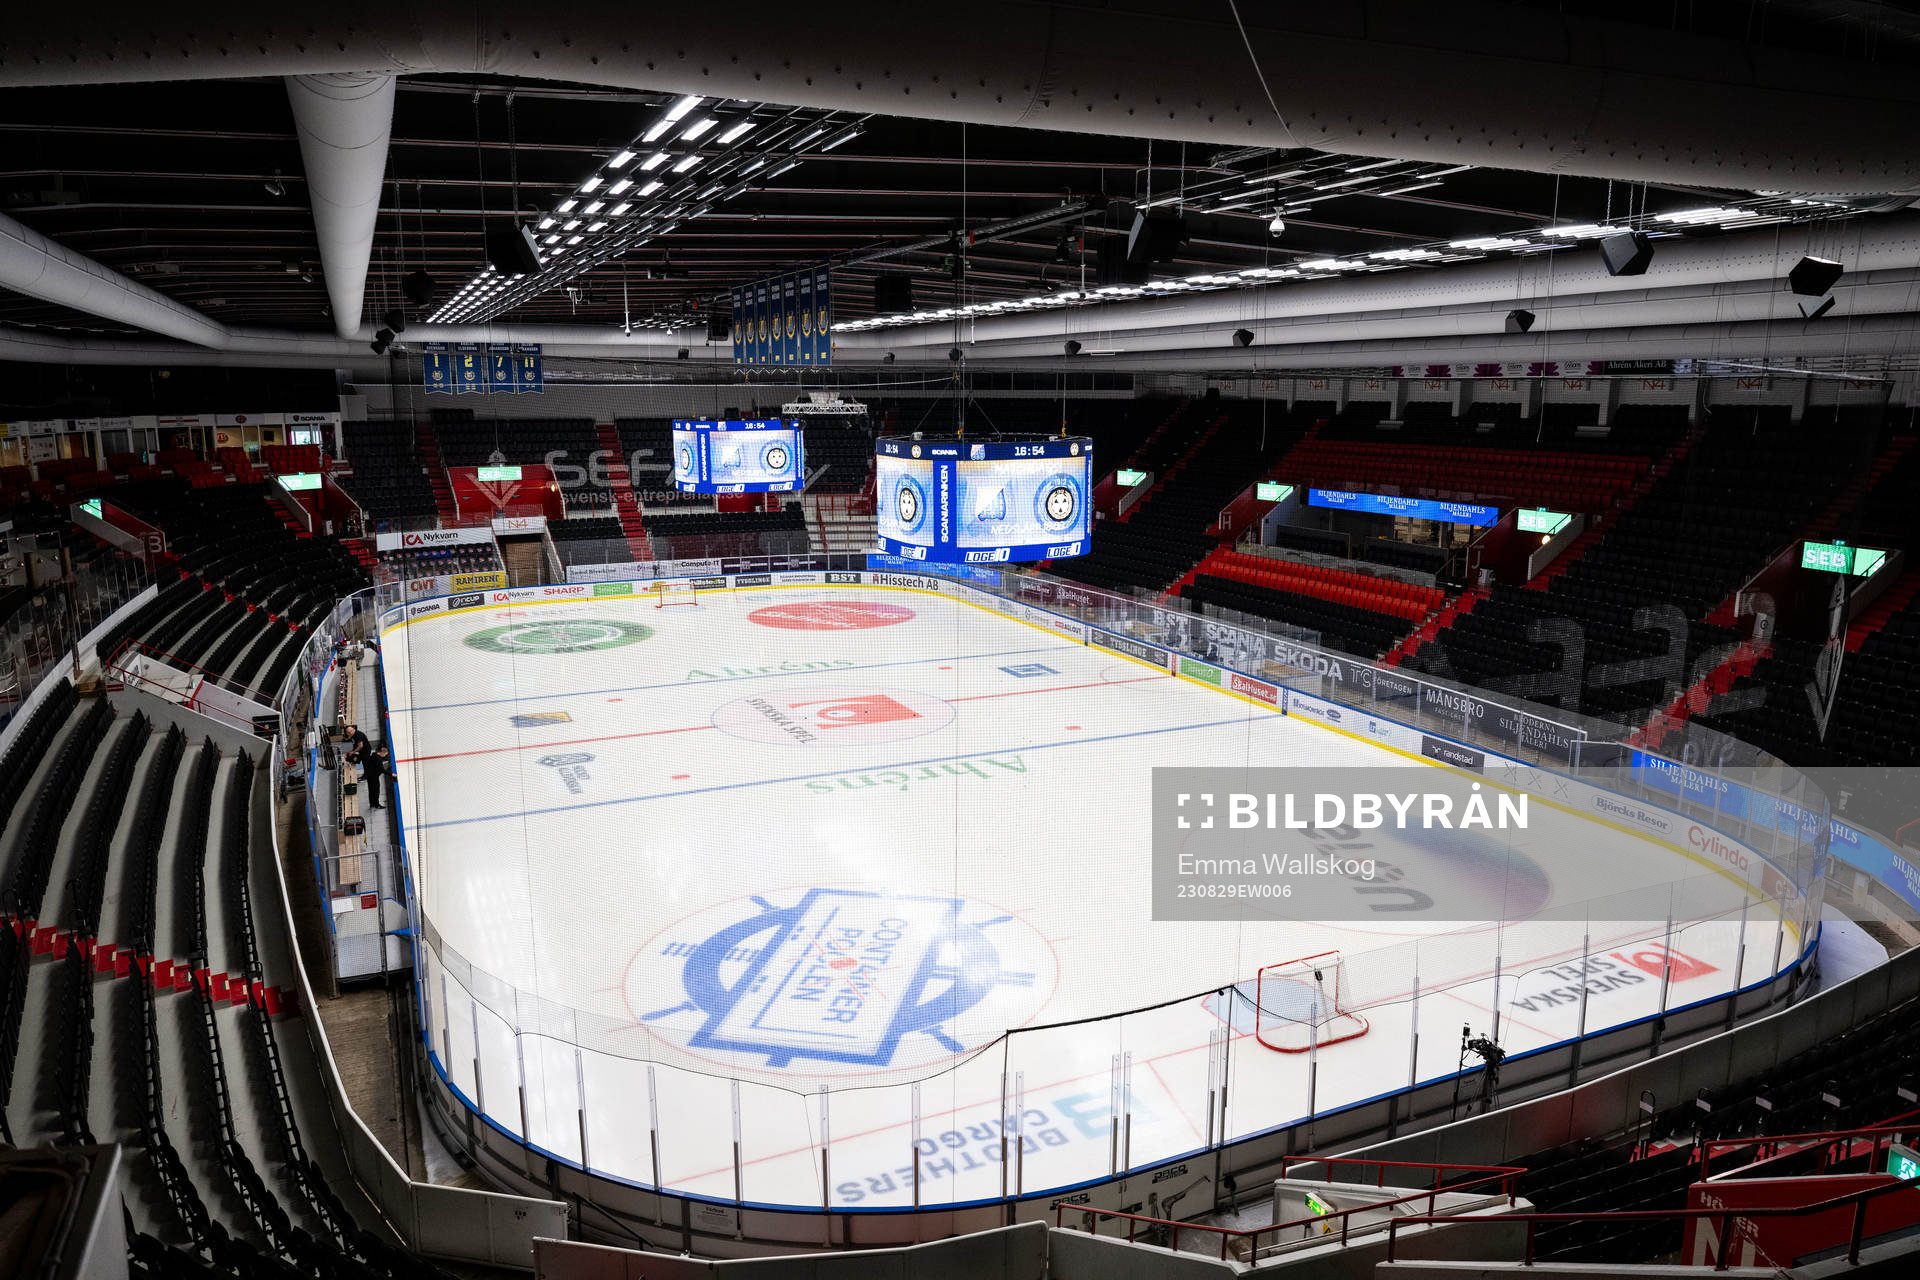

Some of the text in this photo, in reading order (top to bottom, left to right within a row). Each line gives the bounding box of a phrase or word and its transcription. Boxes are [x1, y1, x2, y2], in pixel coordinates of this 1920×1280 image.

[434, 353, 439, 368] 1
[463, 354, 473, 368] 2
[495, 355, 503, 368] 7
[1014, 446, 1045, 456] 16:54
[940, 465, 949, 543] SCANIARINKEN
[1318, 490, 1357, 501] SILJENDAHLS
[1377, 496, 1419, 507] SILJENDAHLS
[1440, 502, 1486, 514] SILJENDAHLS
[1519, 514, 1546, 530] SEB
[149, 536, 163, 553] B
[403, 532, 458, 546] ICA Nykvarn
[1805, 549, 1846, 567] SEB
[456, 574, 499, 585] RAMIRENT
[831, 573, 857, 582] BST
[880, 574, 939, 591] Hisstech AB
[493, 591, 534, 602] ICA Nykvarn
[544, 587, 585, 595] SHARP
[417, 603, 440, 614] SCANIA
[1206, 623, 1266, 657] SCANIA
[686, 658, 855, 681] Ahréns
[1274, 641, 1343, 681] ŠKODA
[1426, 688, 1484, 719] MÅNSBRO
[783, 726, 817, 745] SPEL
[1499, 717, 1569, 749] SILJENDAHLS
[1444, 749, 1474, 765] randstad
[1650, 758, 1729, 794] SILJENDAHLS
[1596, 796, 1669, 831] Björcks Resor
[1687, 825, 1749, 873] Cylinda
[1540, 956, 1617, 981] SPEL
[1509, 970, 1646, 1012] SVENSKA
[911, 1108, 1049, 1157] CARGO
[836, 1128, 1070, 1204] BROTHERS
